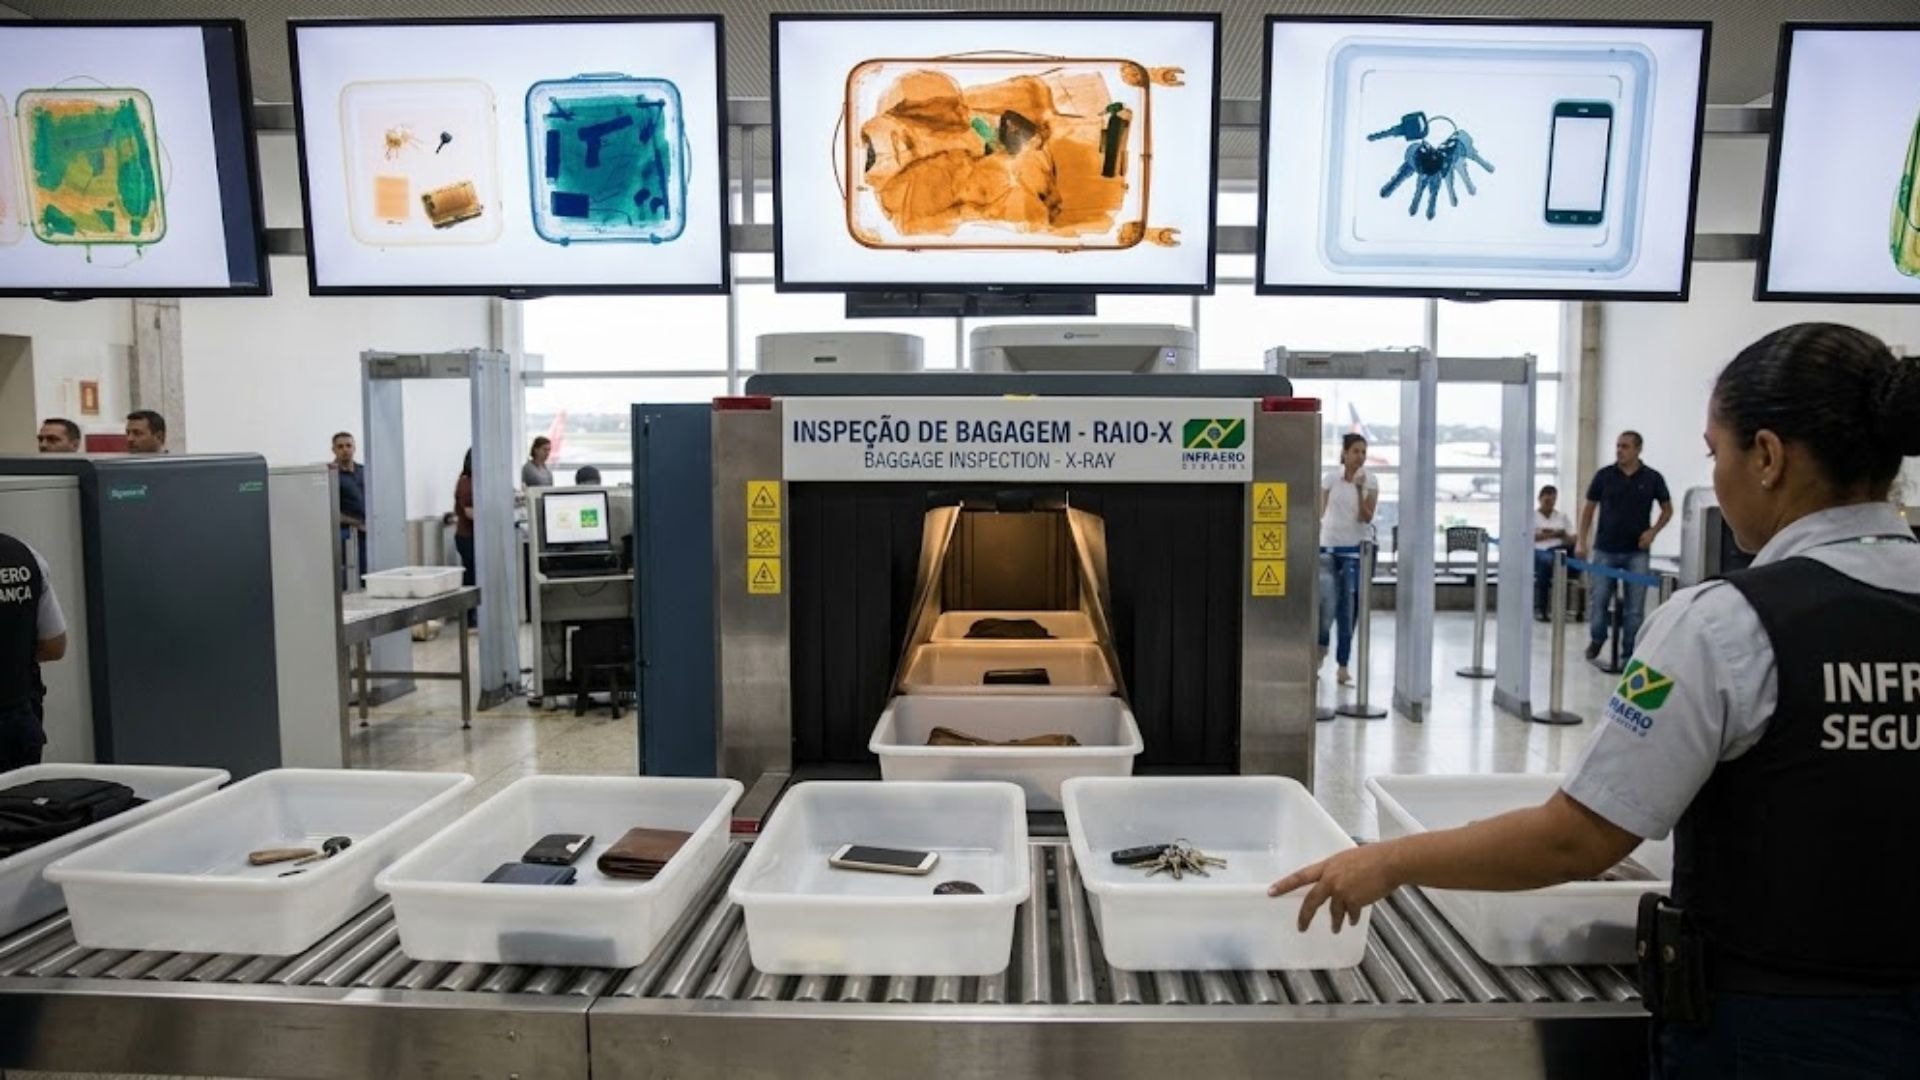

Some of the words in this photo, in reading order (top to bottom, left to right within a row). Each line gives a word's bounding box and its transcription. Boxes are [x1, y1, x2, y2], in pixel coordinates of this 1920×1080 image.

[793, 415, 911, 449] INSPEÇÃO
[918, 420, 948, 444] DE
[955, 420, 1071, 444] BAGAGEM
[1093, 420, 1173, 444] RAIO-X
[864, 451, 944, 469] BAGGAGE
[949, 451, 1050, 469] INSPECTION
[1065, 451, 1116, 469] X-RAY
[1181, 451, 1246, 463] INFRAERO
[0, 566, 32, 584] ERO
[1823, 662, 1920, 702] INFR
[1821, 714, 1920, 750] SEGU
